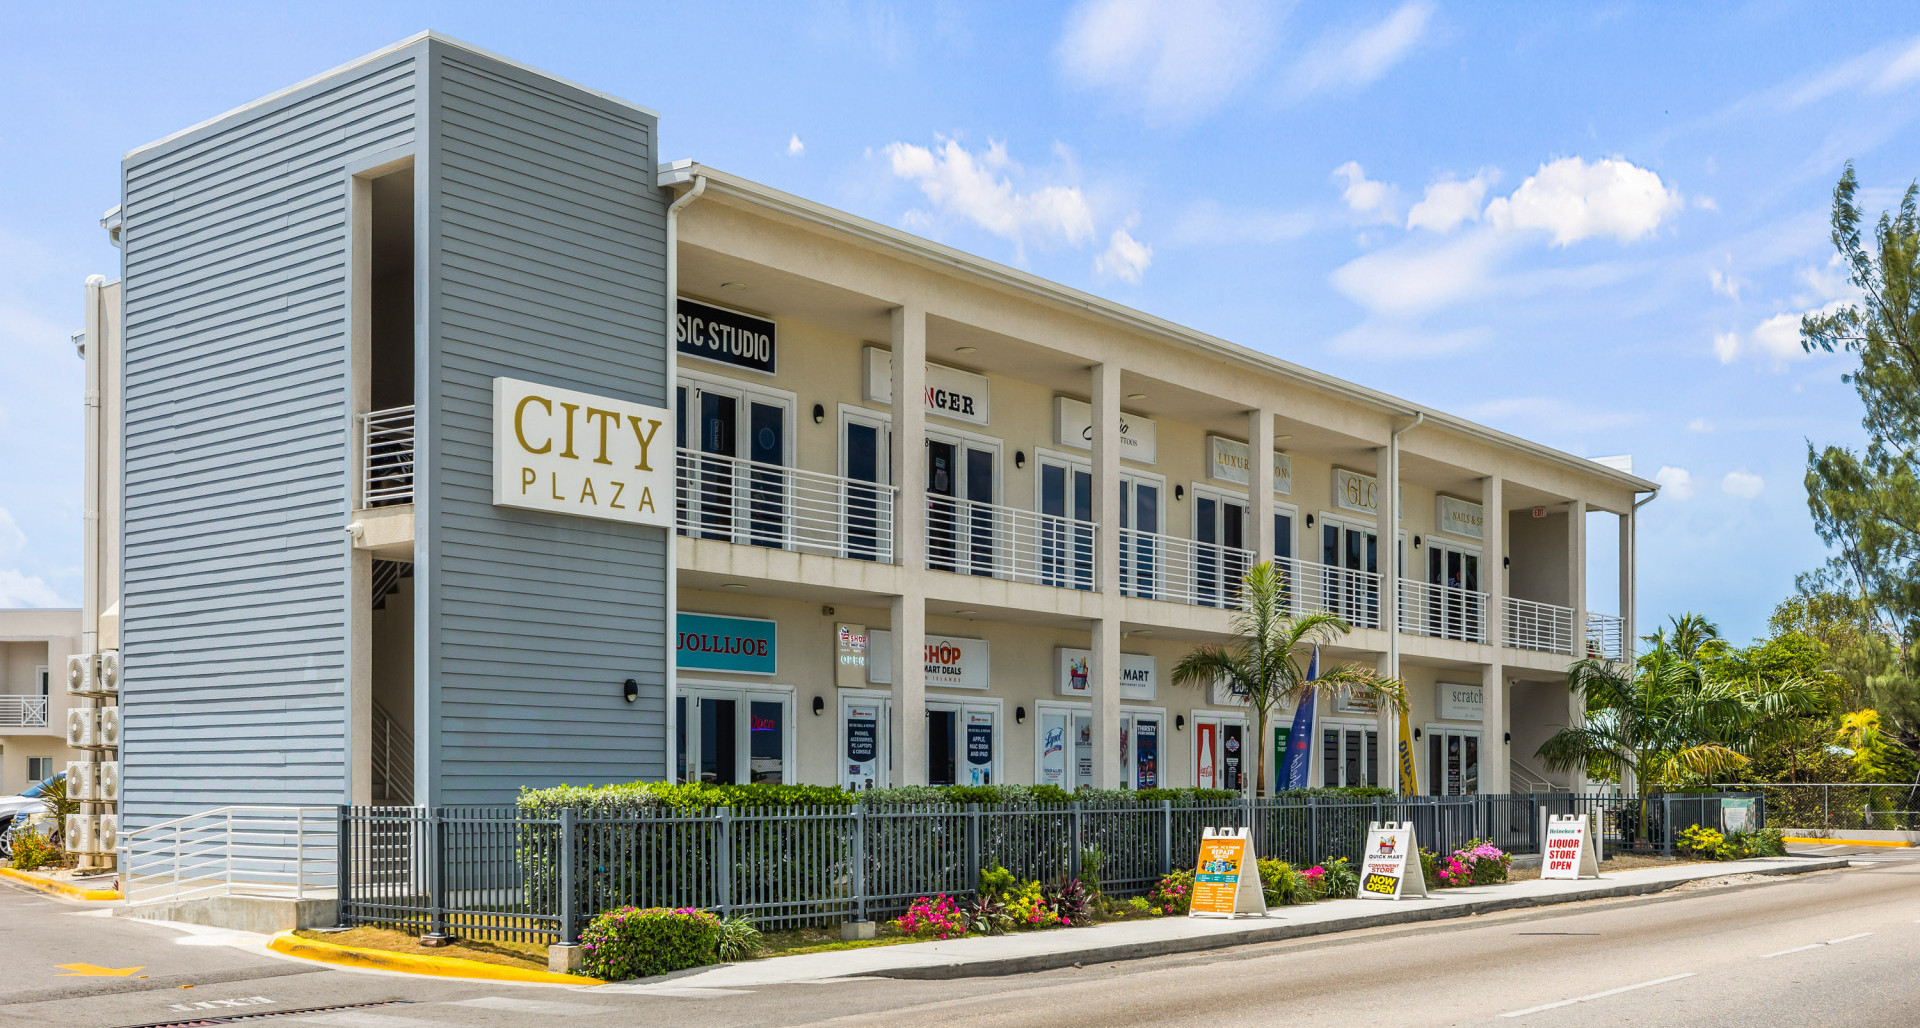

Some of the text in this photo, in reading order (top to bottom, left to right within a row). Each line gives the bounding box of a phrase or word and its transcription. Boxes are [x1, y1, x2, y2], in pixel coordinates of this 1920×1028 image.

[708, 322, 770, 362] STUDIO
[696, 388, 701, 398] 7
[514, 395, 662, 472] CITY
[522, 467, 655, 514] PLAZA
[1534, 508, 1544, 516] EXIT
[1452, 511, 1469, 524] NAILS
[676, 632, 768, 656] JOLLIJOE
[942, 666, 962, 675] DEALS
[1124, 669, 1149, 682] MART
[1452, 690, 1483, 703] scratch
[1549, 839, 1579, 848] LIQUOR
[1549, 850, 1576, 859] STORE
[1550, 861, 1572, 870] OPEN
[1370, 875, 1396, 885] NOW
[1366, 884, 1394, 894] OPEN
